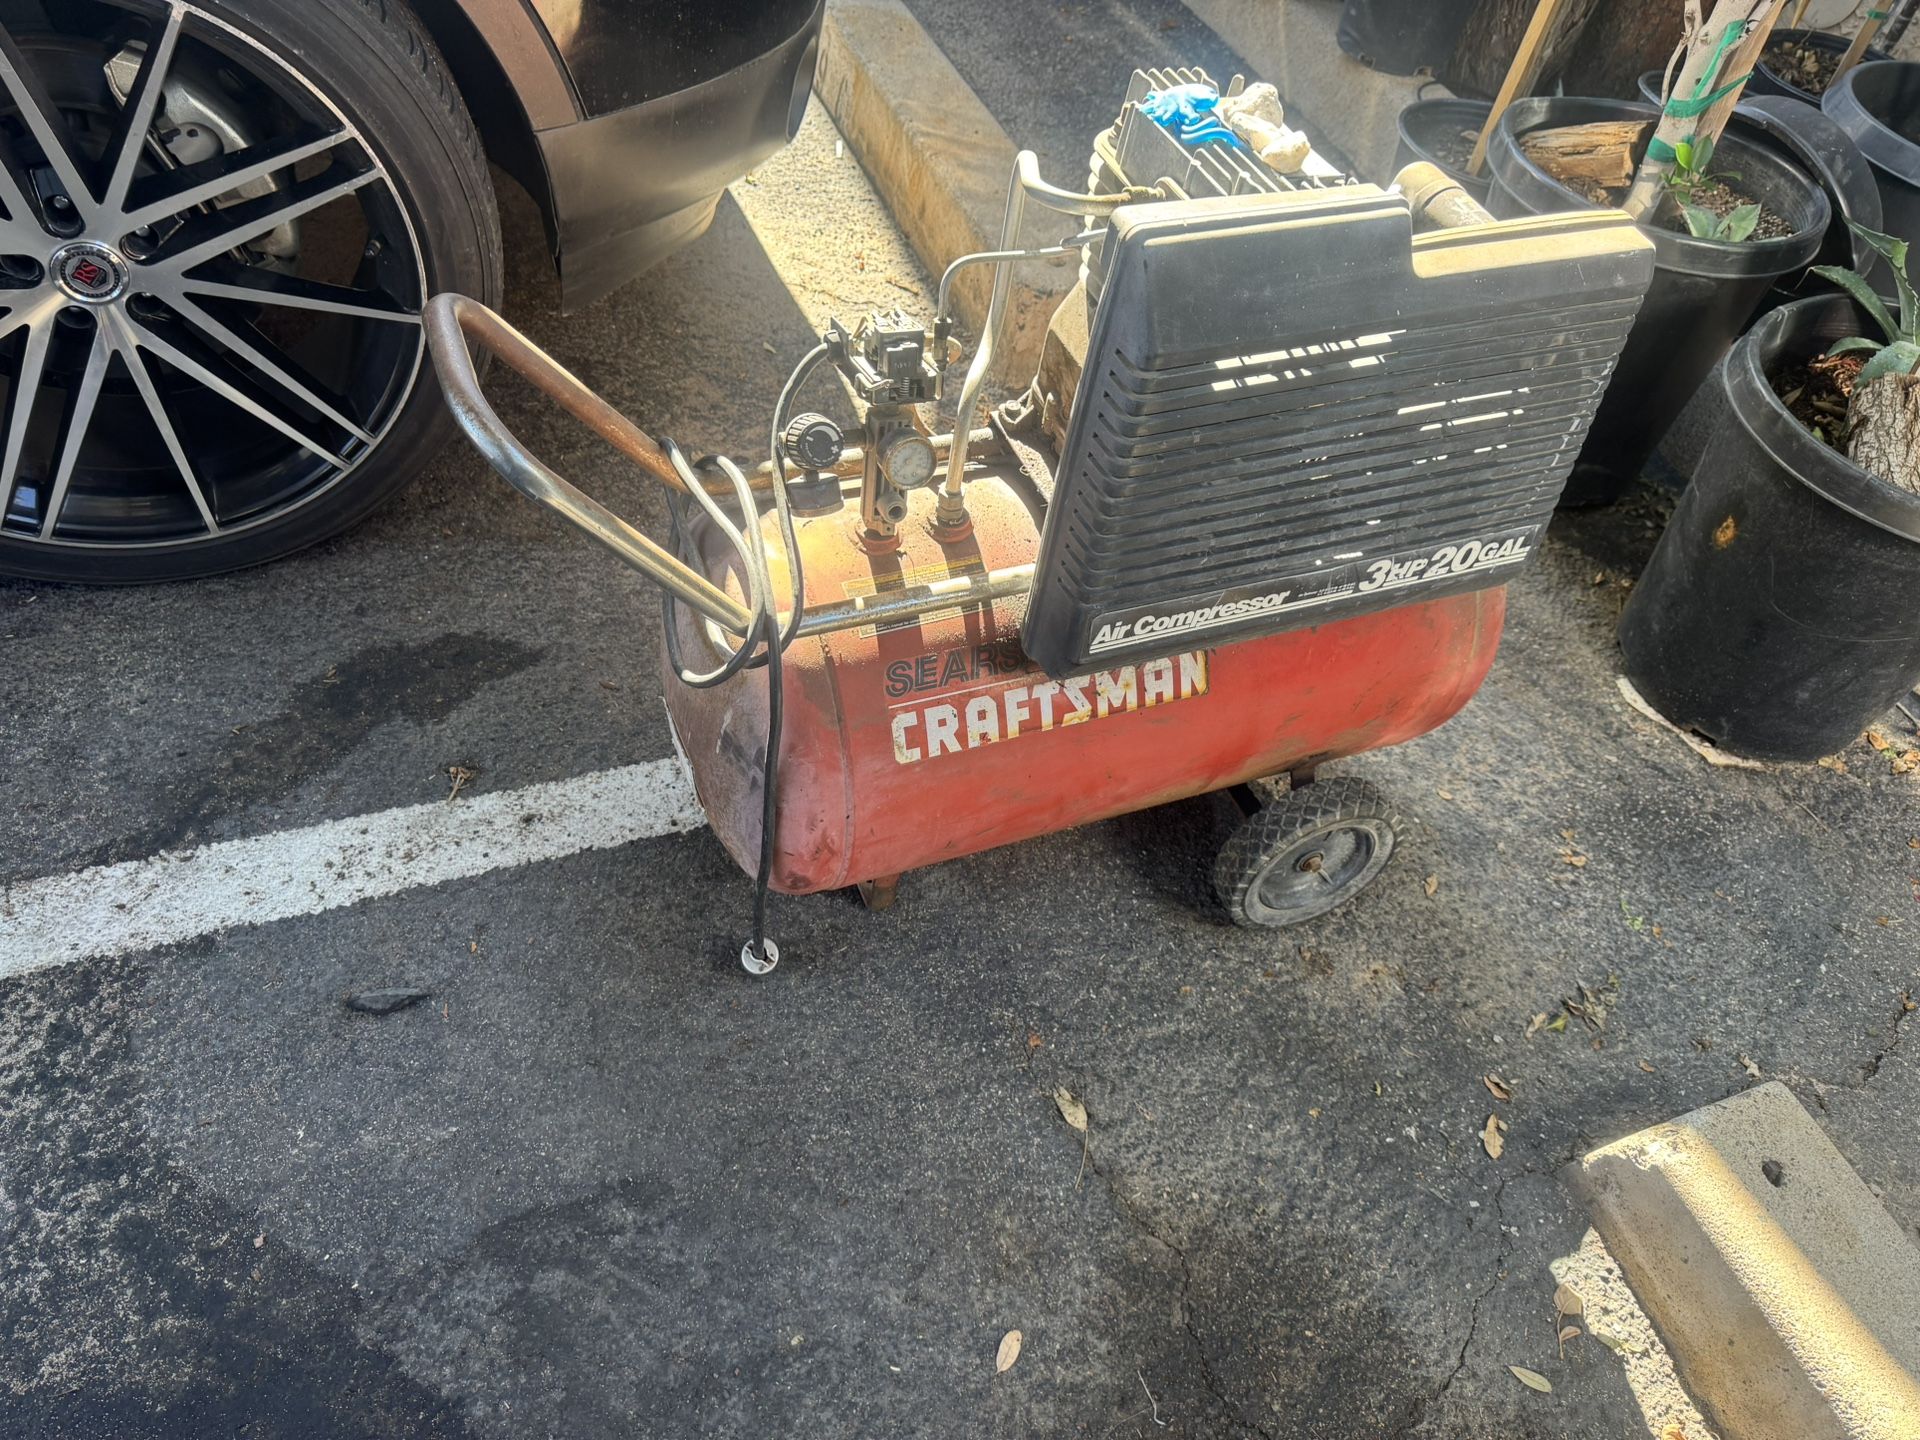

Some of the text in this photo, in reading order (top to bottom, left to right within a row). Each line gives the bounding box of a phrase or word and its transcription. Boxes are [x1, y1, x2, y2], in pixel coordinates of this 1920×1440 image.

[1092, 621, 1132, 645] Air
[1133, 589, 1291, 628] Compressor
[885, 643, 1021, 698] SEARS
[891, 650, 1209, 764] CRAFTSMAN
